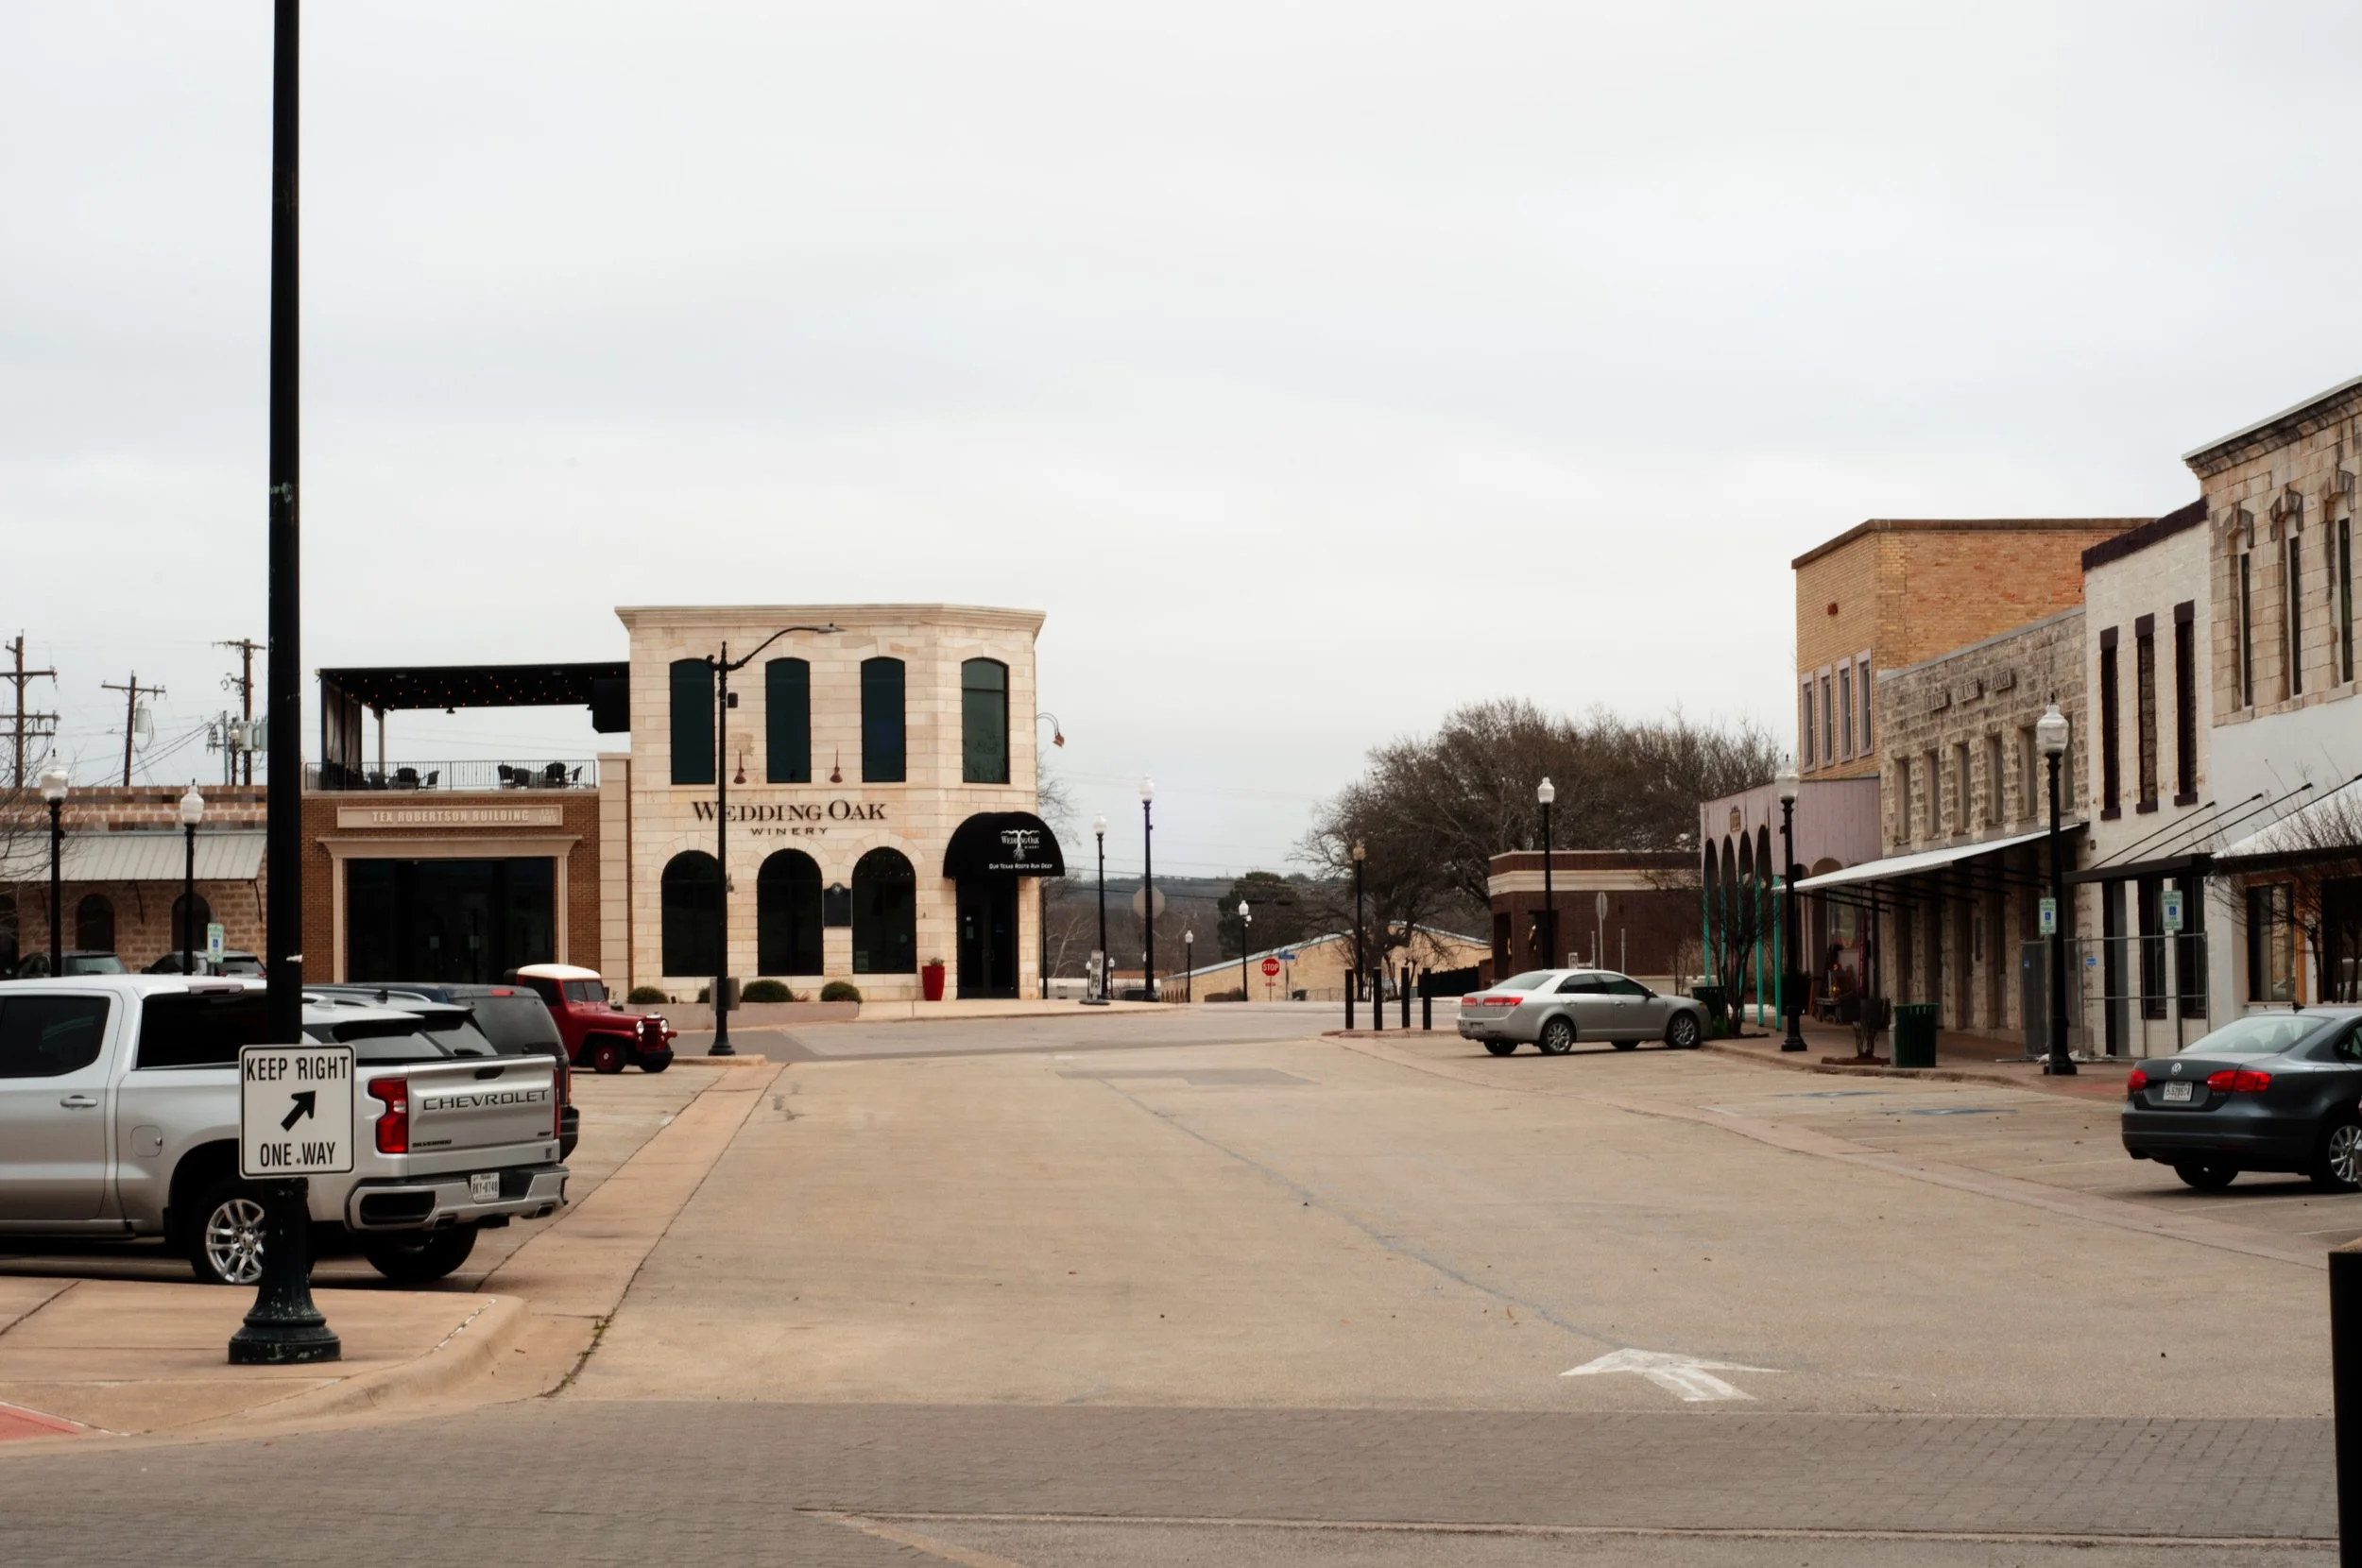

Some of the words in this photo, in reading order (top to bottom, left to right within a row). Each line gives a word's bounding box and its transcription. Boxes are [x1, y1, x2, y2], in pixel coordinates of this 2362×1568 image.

[372, 810, 393, 823] TEX
[397, 810, 468, 823] ROBERTSON
[472, 810, 530, 822] BUILDING
[692, 800, 822, 822] WEDDING
[828, 799, 887, 821] OAK
[751, 827, 829, 836] WINERY
[247, 1057, 288, 1081] KEEP
[298, 1056, 349, 1080] RIGHT
[423, 1089, 549, 1111] CHEVROLET
[260, 1143, 292, 1167] ONE
[302, 1141, 335, 1165] WAY
